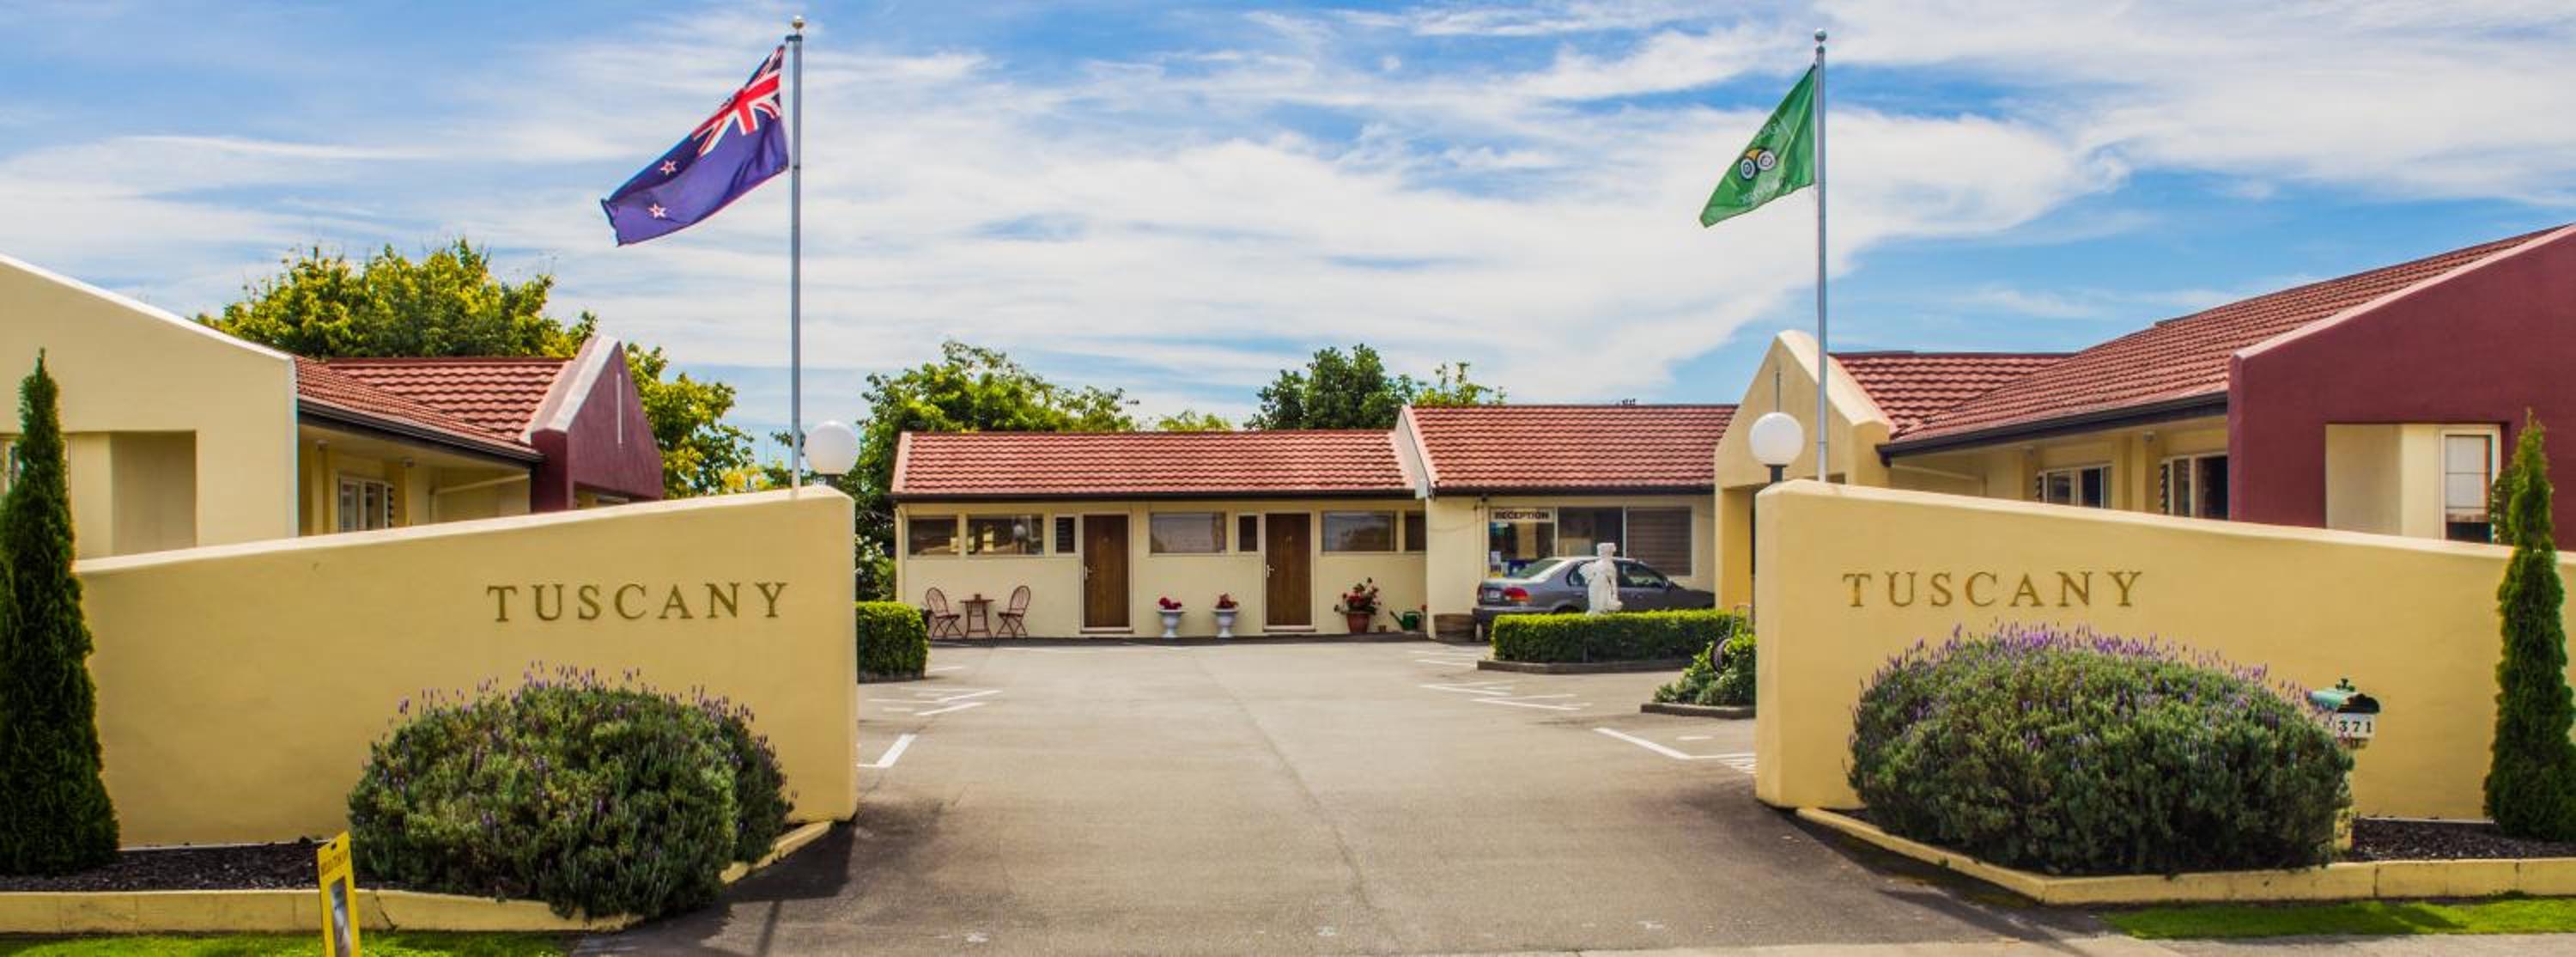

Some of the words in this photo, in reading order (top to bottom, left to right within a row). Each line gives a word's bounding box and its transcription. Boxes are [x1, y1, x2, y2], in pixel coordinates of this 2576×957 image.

[1495, 511, 1549, 520] RECEPTION
[1842, 571, 2143, 607] TUSCANY
[487, 582, 788, 623] TUSCANY
[2339, 720, 2372, 734] 371
